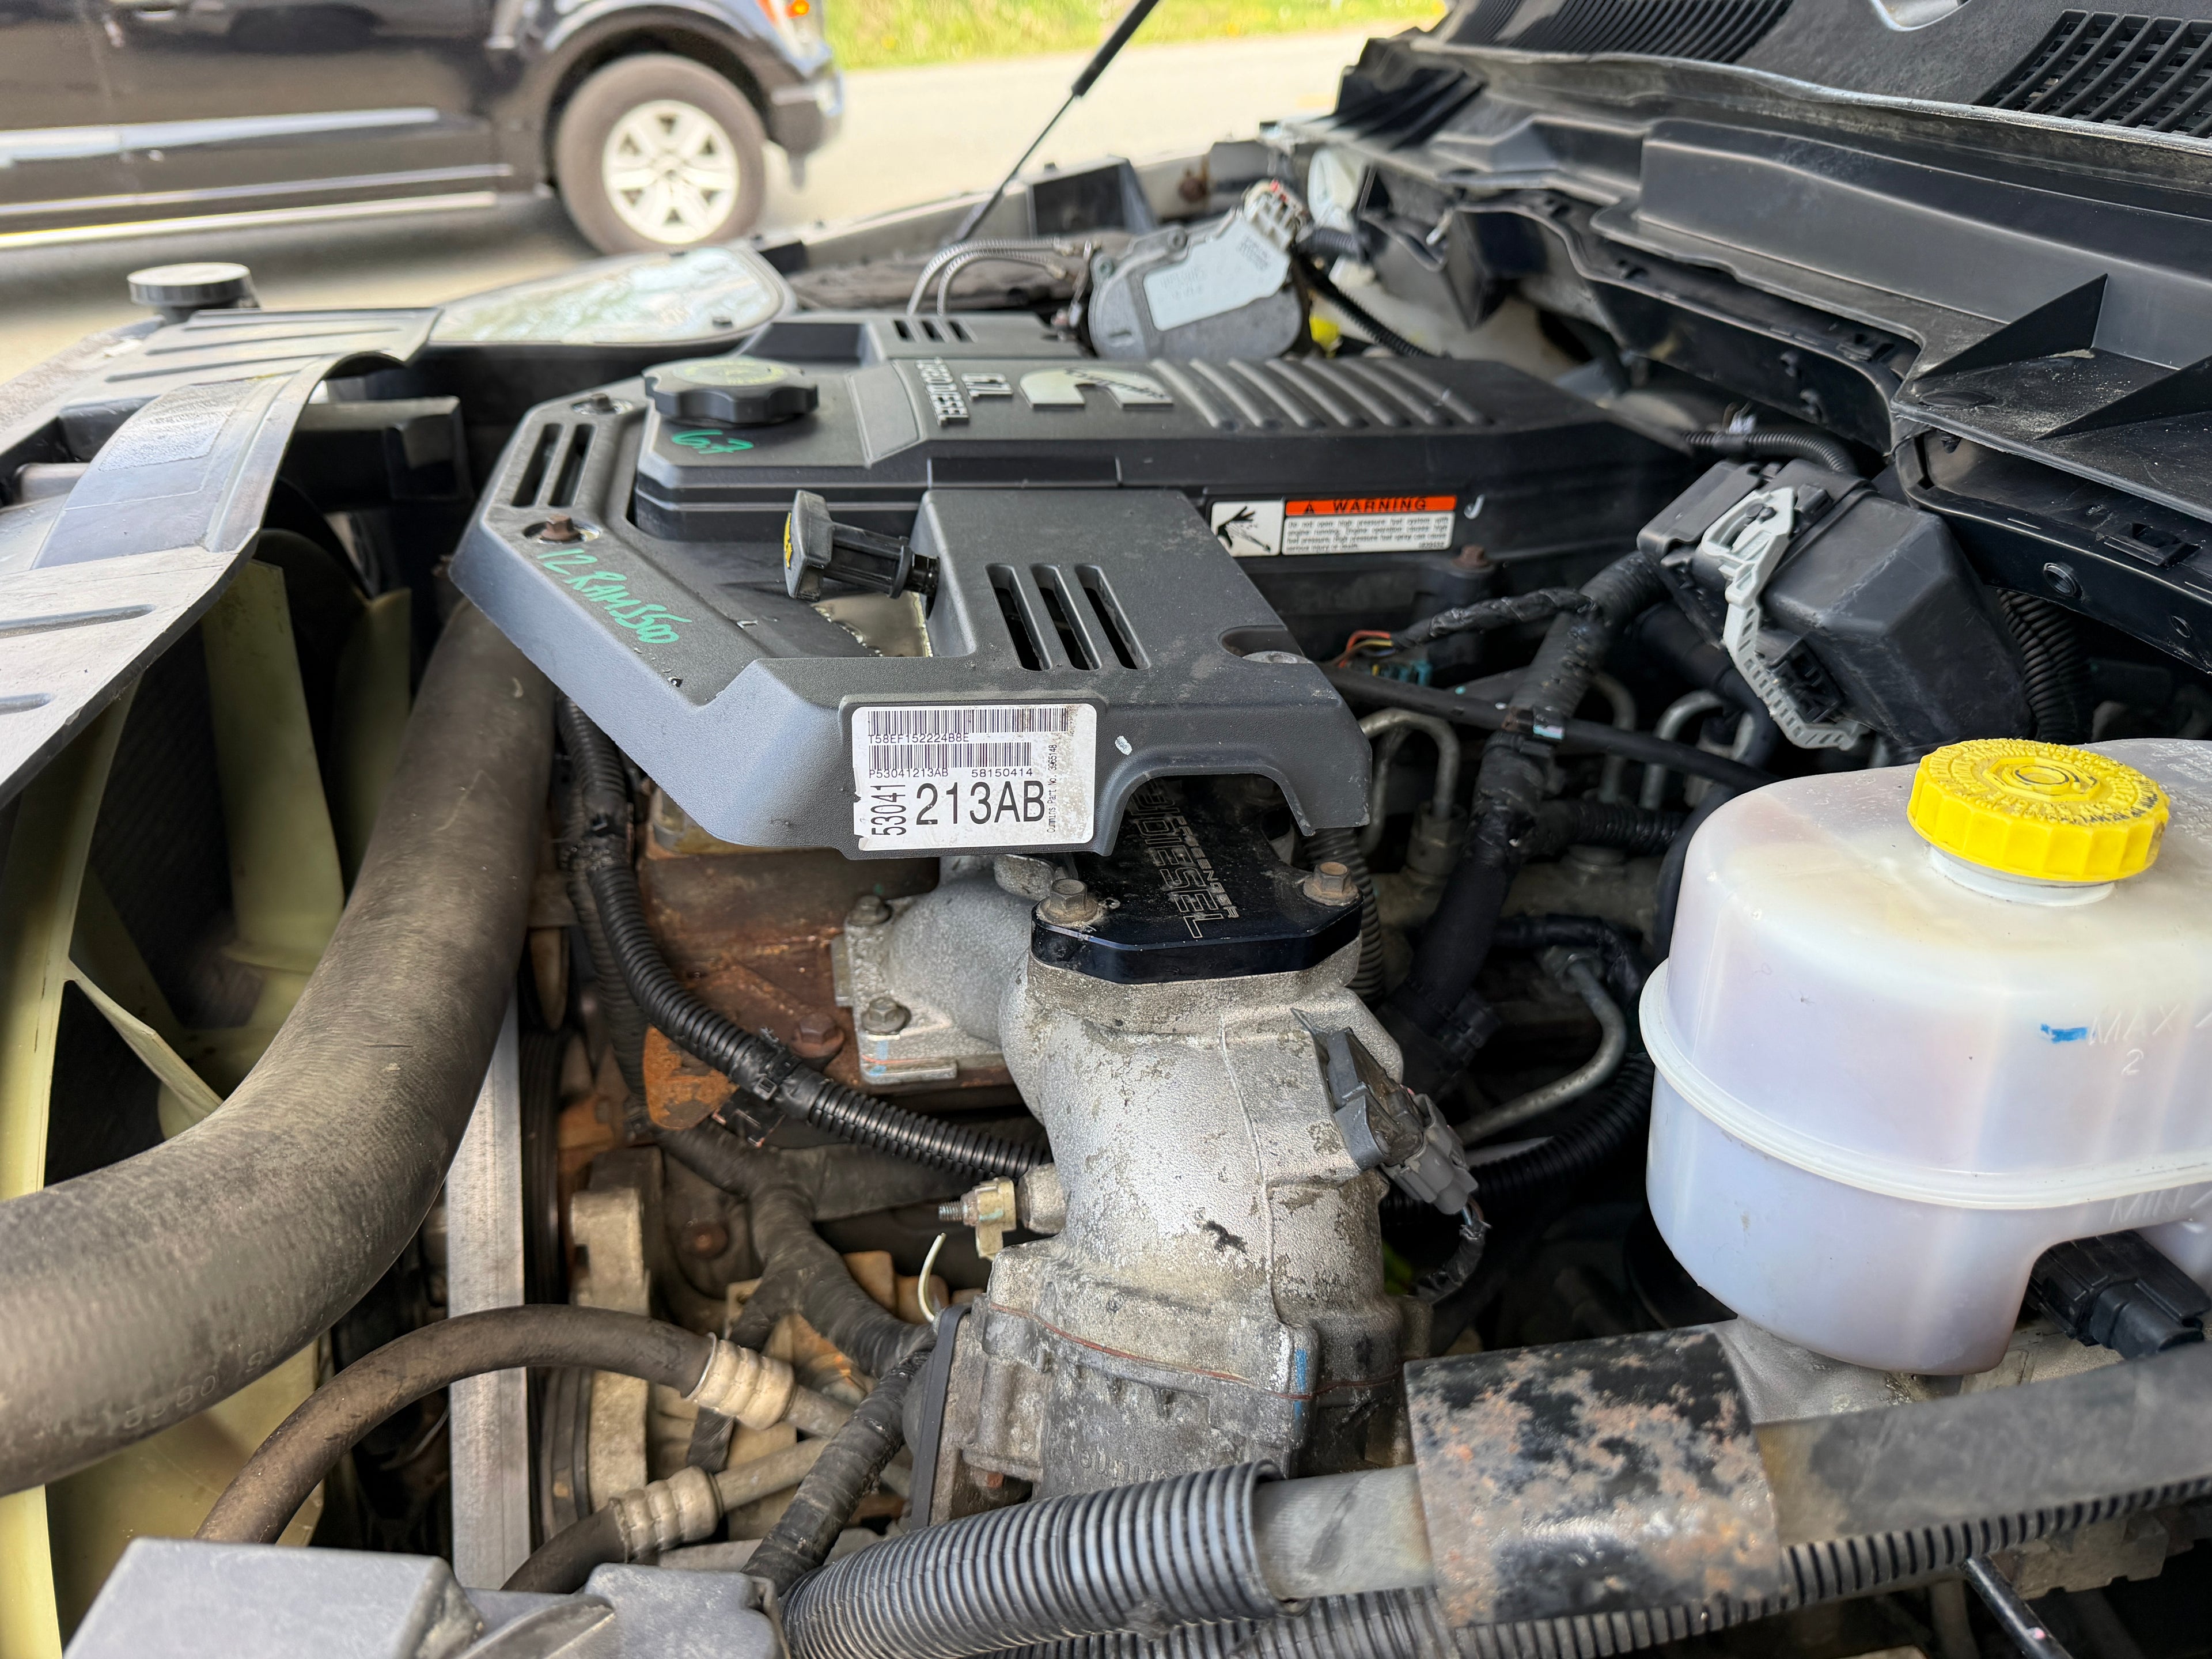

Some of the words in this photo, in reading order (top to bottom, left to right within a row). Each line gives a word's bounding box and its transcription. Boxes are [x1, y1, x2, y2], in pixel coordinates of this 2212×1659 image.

[1333, 499, 1426, 514] WARNING
[536, 548, 598, 575] 12
[563, 570, 642, 611] RAM
[868, 733, 969, 744] T58EF152224B8E
[1047, 744, 1058, 771] 3965148
[869, 768, 949, 779] P53041213AB
[971, 767, 1033, 778] 58150414
[1048, 774, 1057, 787] No.
[870, 783, 907, 836] 53041
[915, 779, 1046, 825] 213AB
[1048, 789, 1057, 805] Part
[1046, 806, 1056, 834] Cummins
[1133, 816, 1225, 939] DIESEL
[2088, 1003, 2180, 1047] MAX
[2120, 1048, 2144, 1076] 2
